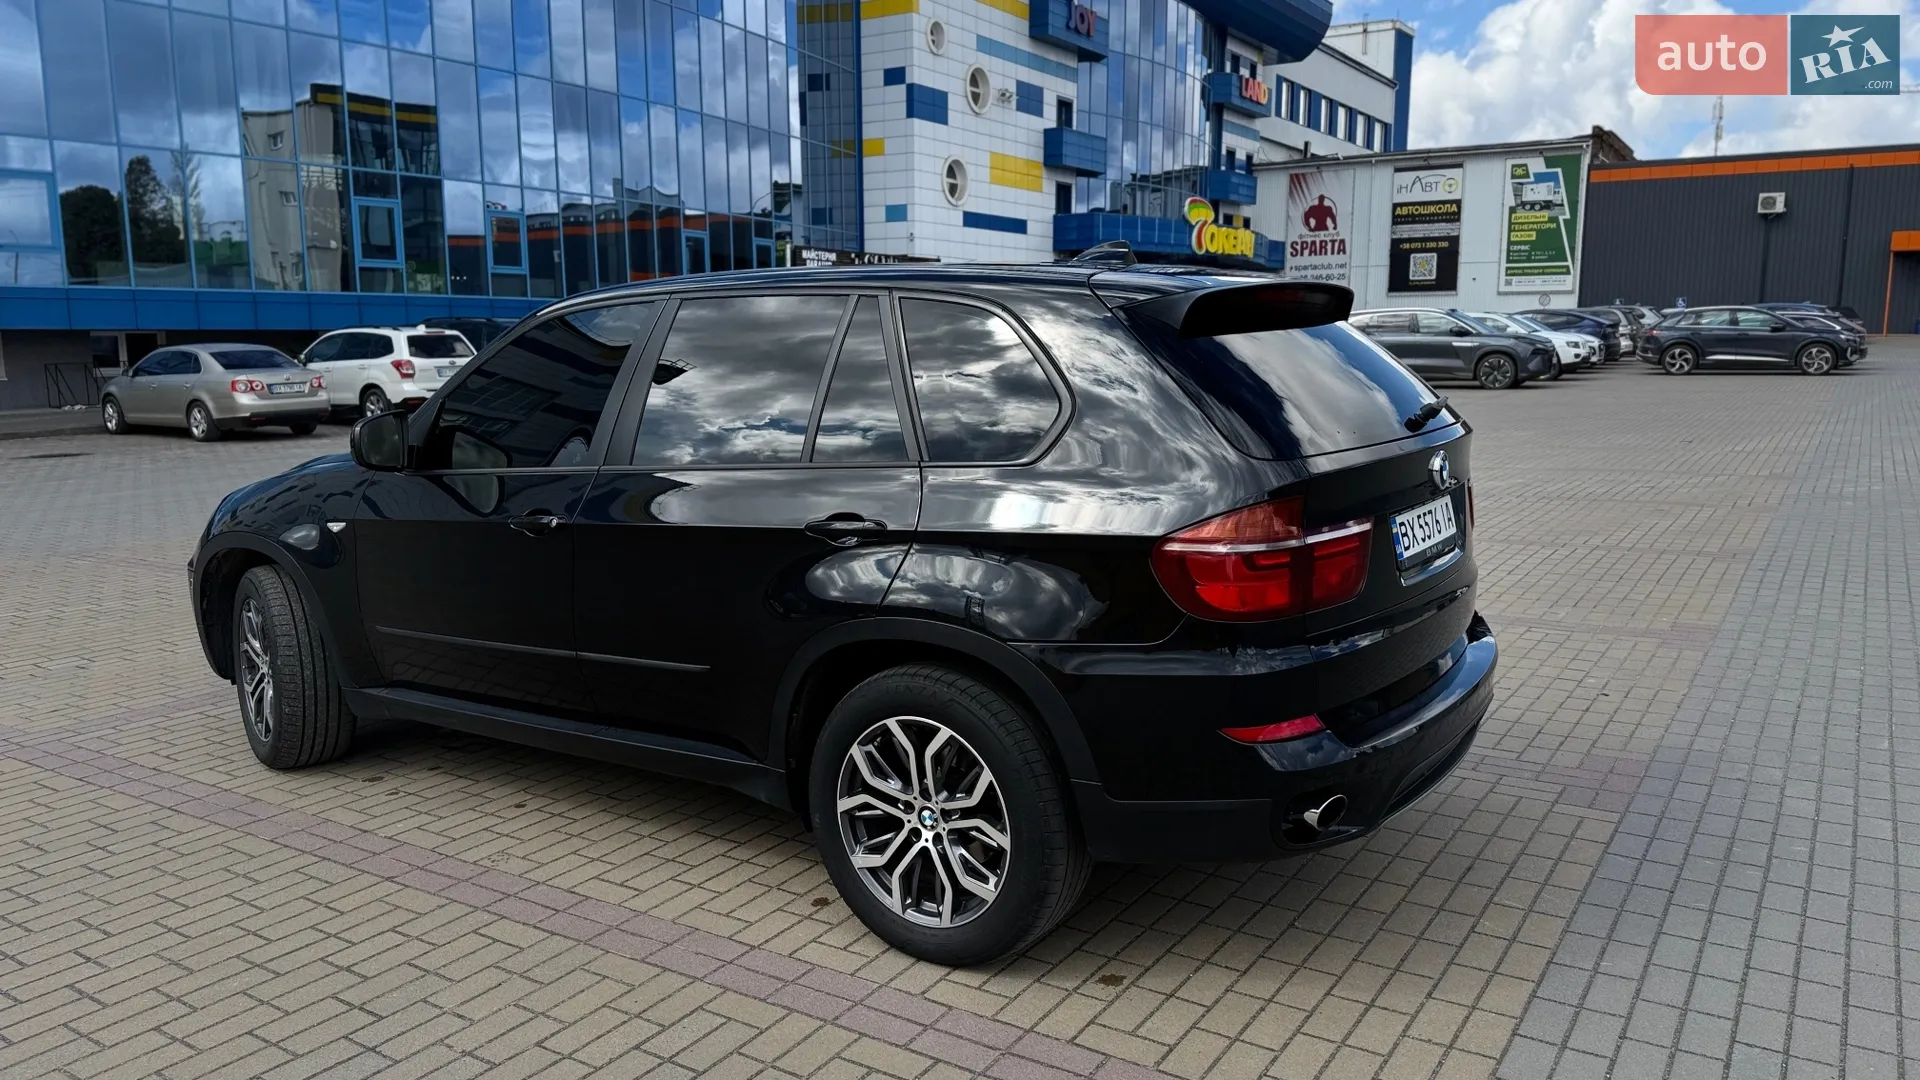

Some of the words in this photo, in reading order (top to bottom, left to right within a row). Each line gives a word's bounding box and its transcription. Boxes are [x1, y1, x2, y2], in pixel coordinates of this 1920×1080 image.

[1068, 0, 1097, 37] JOY
[1240, 75, 1269, 105] LAND
[1395, 203, 1458, 216] АВТОШКОЛА
[1298, 232, 1321, 240] фітнес
[1323, 231, 1340, 239] клуб
[802, 248, 837, 262] МАЙСТЕРНЯ
[1290, 238, 1347, 257] SPARTA
[1398, 516, 1420, 553] BX
[1417, 506, 1442, 544] 5576
[1440, 501, 1455, 532] IA
[1425, 544, 1443, 557] BMW
